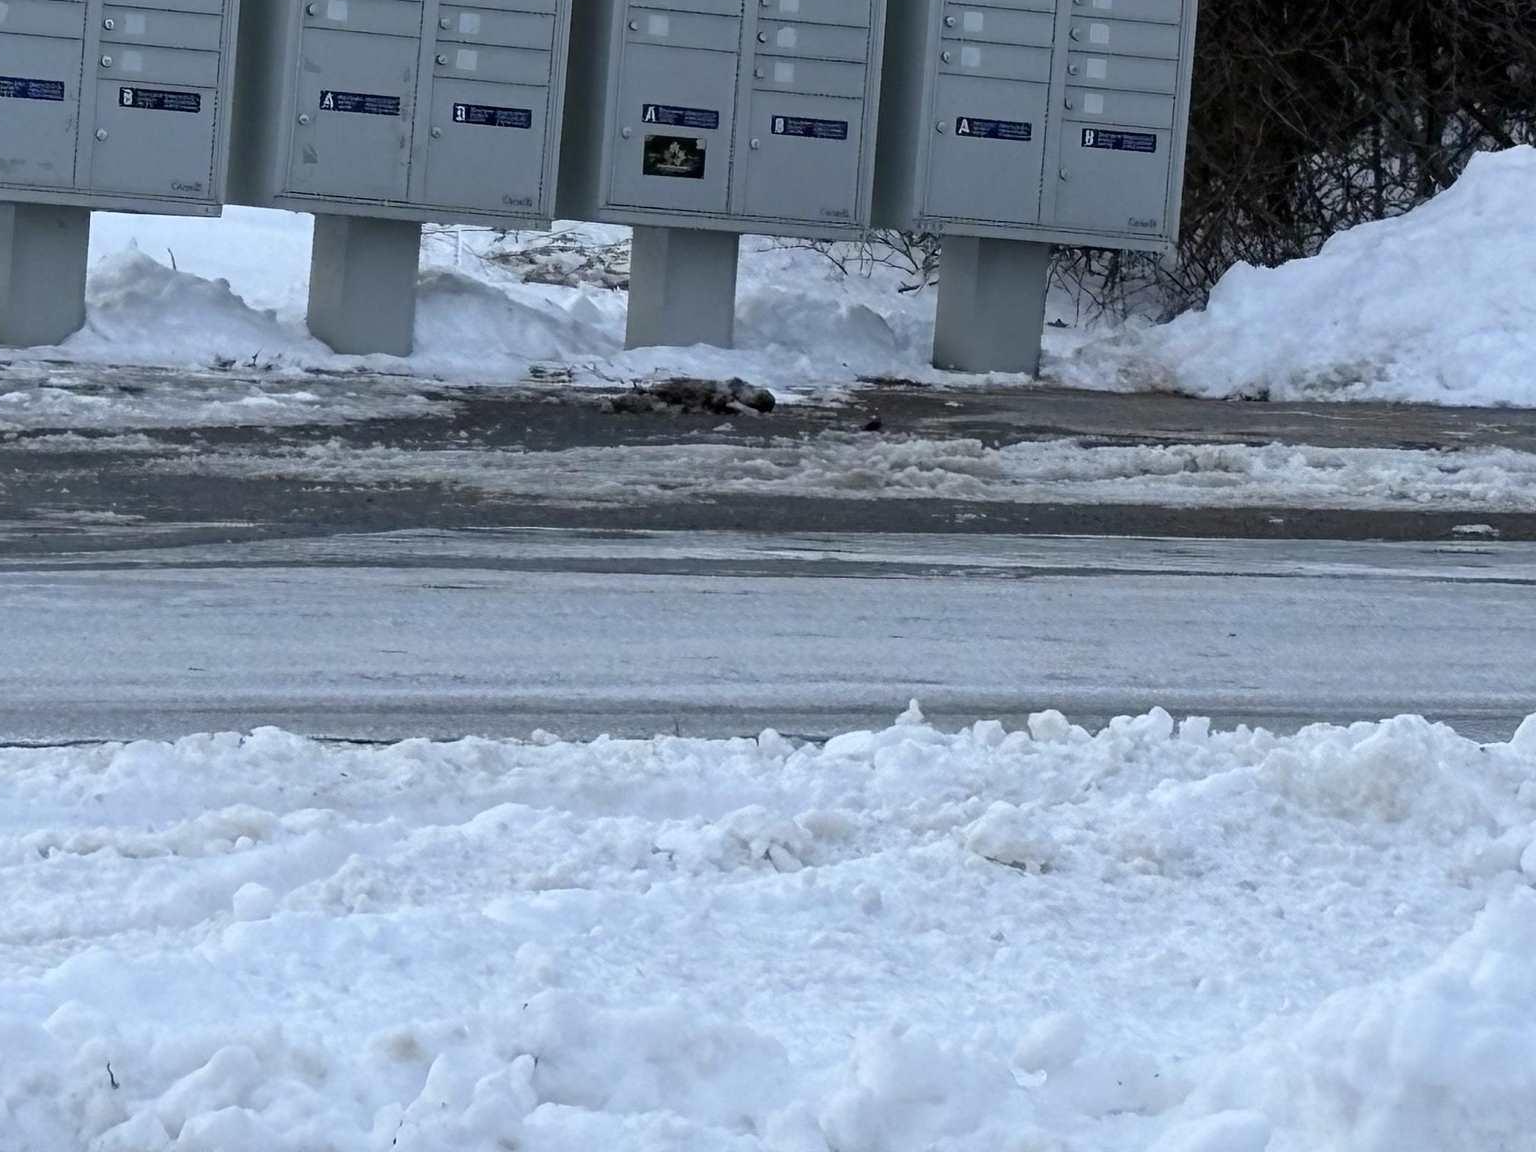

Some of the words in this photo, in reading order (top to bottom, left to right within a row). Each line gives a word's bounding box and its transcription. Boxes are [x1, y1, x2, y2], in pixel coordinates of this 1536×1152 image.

[123, 88, 134, 105] B
[321, 92, 334, 109] A
[645, 106, 656, 123] A
[958, 118, 970, 135] A
[1084, 129, 1094, 146] B
